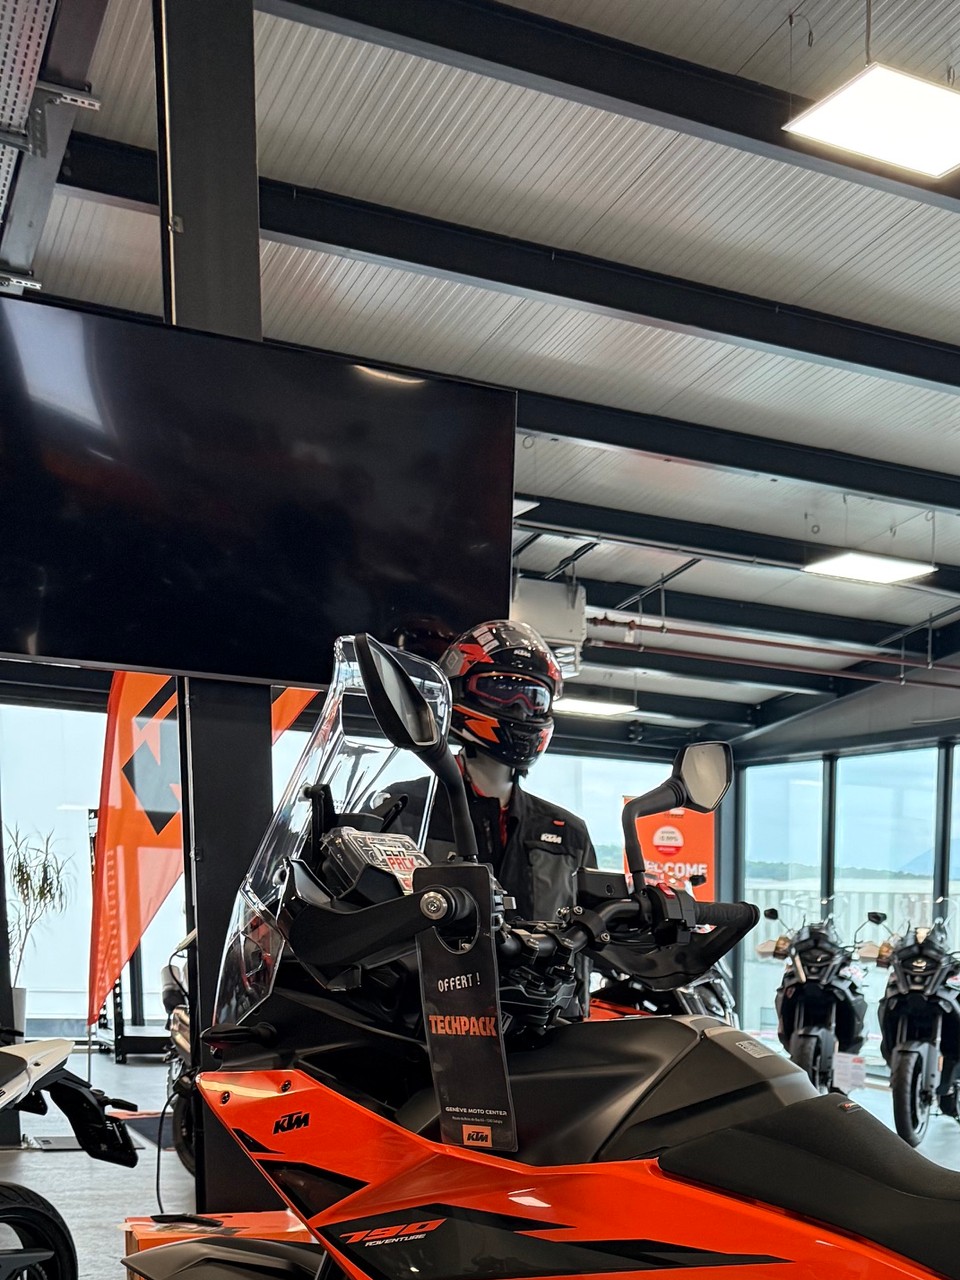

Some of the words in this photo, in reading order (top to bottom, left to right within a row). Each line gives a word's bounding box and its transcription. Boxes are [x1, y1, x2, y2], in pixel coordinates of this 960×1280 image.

[437, 973, 474, 993] OFFERT
[428, 1014, 497, 1038] TECHPACK
[272, 1111, 310, 1135] KTM
[467, 1130, 489, 1143] KTM
[340, 1218, 447, 1244] 790
[364, 1233, 426, 1247] ADVENTURE
